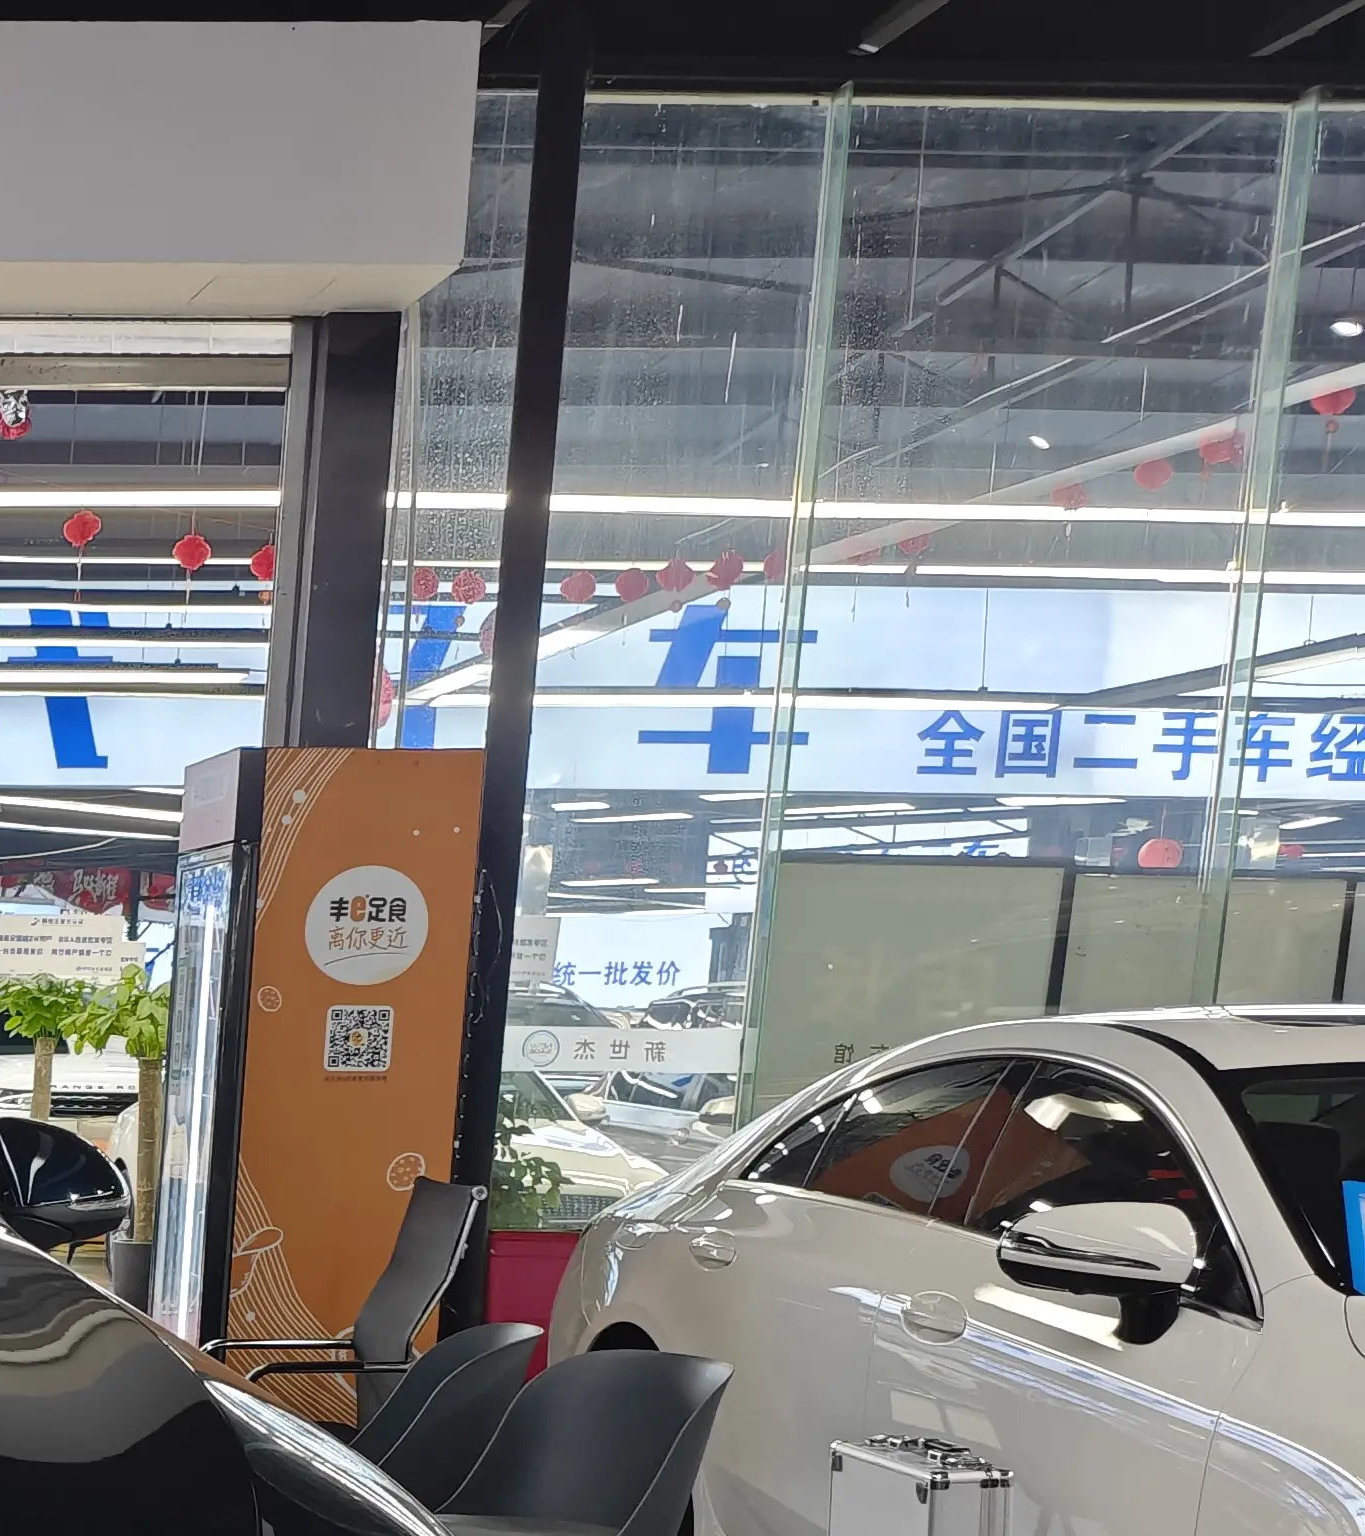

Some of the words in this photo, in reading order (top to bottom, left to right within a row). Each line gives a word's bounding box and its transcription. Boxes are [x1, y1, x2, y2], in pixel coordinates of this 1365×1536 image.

[329, 895, 407, 923] 丰e足食
[328, 926, 408, 951] 离你更近
[552, 960, 680, 987] 统一批发价
